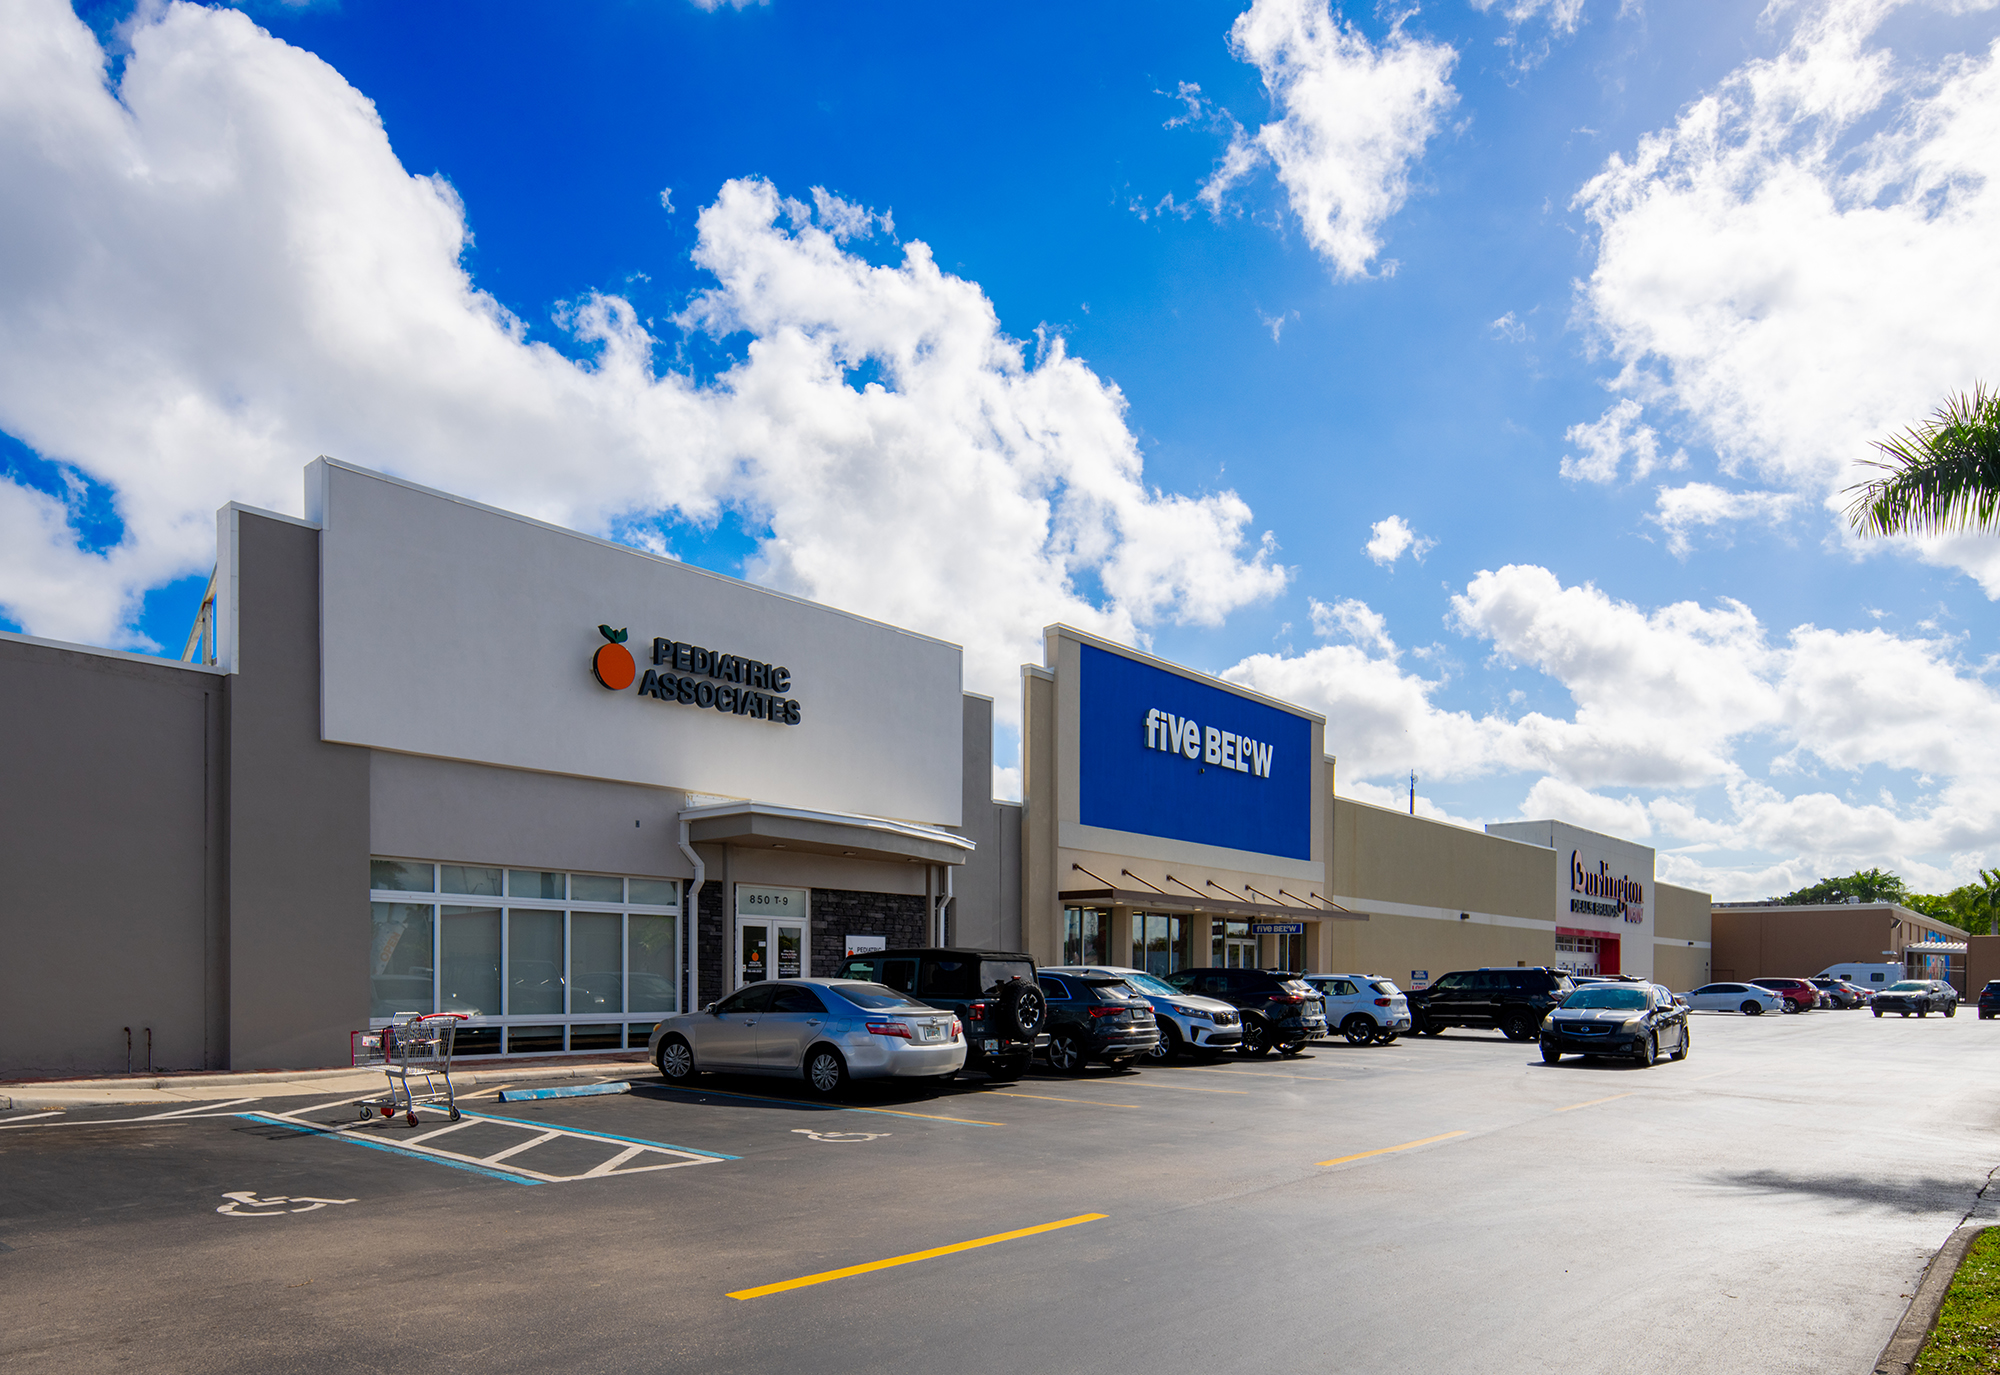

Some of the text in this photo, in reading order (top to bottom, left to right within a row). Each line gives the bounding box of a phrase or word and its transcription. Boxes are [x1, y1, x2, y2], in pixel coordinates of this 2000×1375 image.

[653, 637, 791, 693] PEDIATRIC
[638, 669, 801, 725] ASSOCIATES
[1202, 726, 1273, 778] BELOW
[750, 894, 788, 905] 850 T-9
[1570, 849, 1644, 914] Burlington
[381, 932, 400, 961] OPEN
